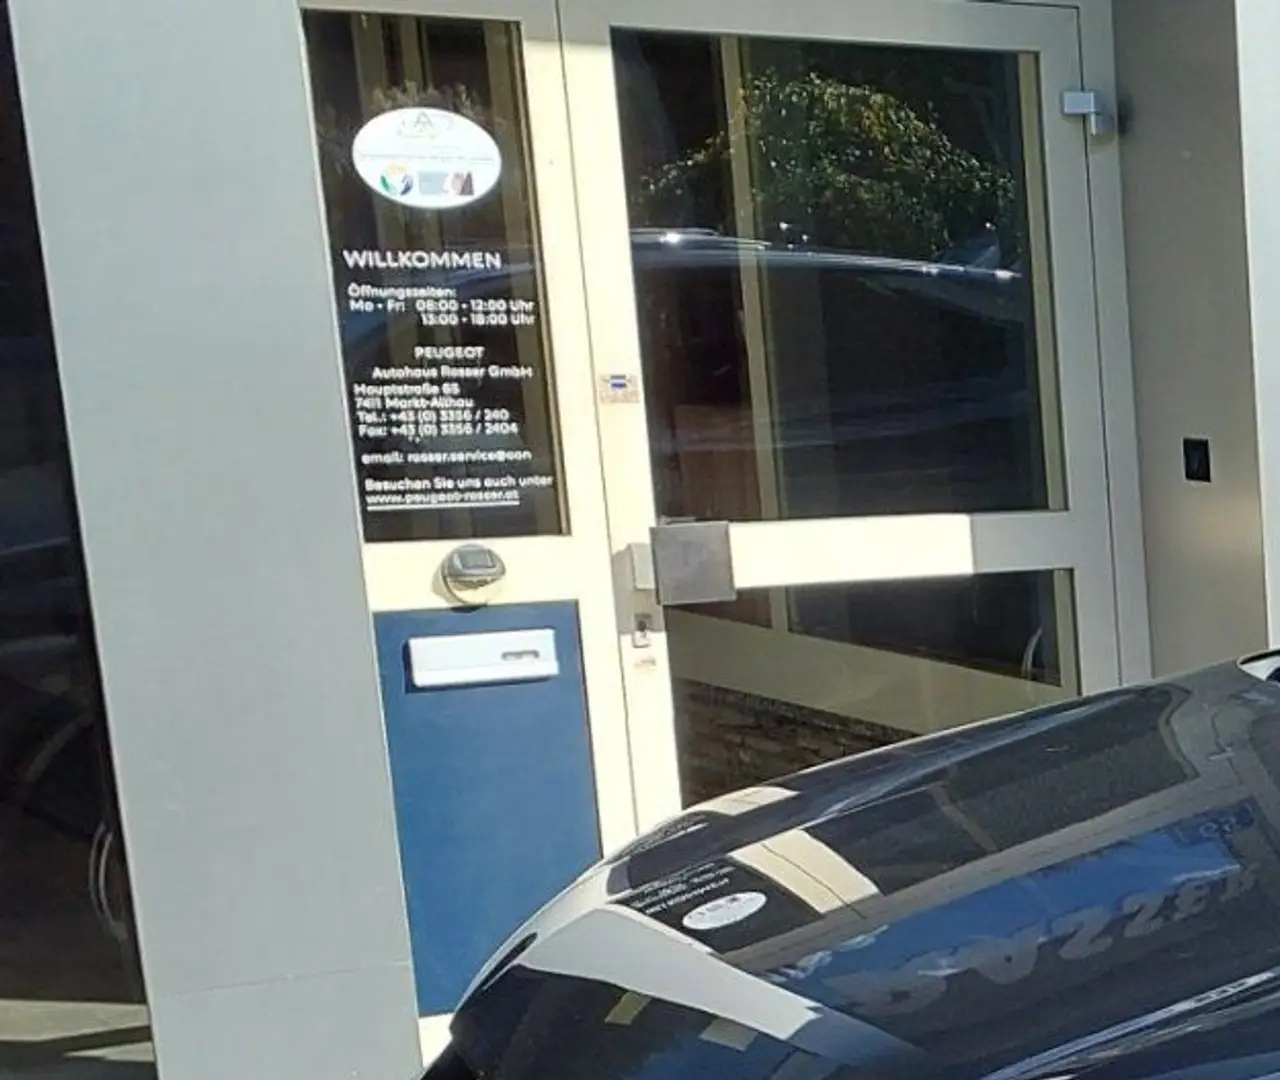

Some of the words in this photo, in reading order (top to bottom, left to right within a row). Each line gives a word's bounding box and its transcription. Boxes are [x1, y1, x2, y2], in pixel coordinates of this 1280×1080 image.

[343, 250, 502, 269] WILLKOMMEN
[350, 300, 373, 312] Mo
[415, 300, 458, 312] 08:00
[510, 300, 535, 312] Uhr
[511, 313, 535, 325] Uhr
[414, 346, 485, 359] PEUGEOT
[372, 366, 439, 379] Autohaus
[488, 364, 533, 378] GmbH
[365, 477, 431, 491] Besuchen
[433, 476, 454, 489] Sie
[457, 478, 480, 488] uns
[484, 475, 516, 487] auch
[519, 475, 553, 487] unter
